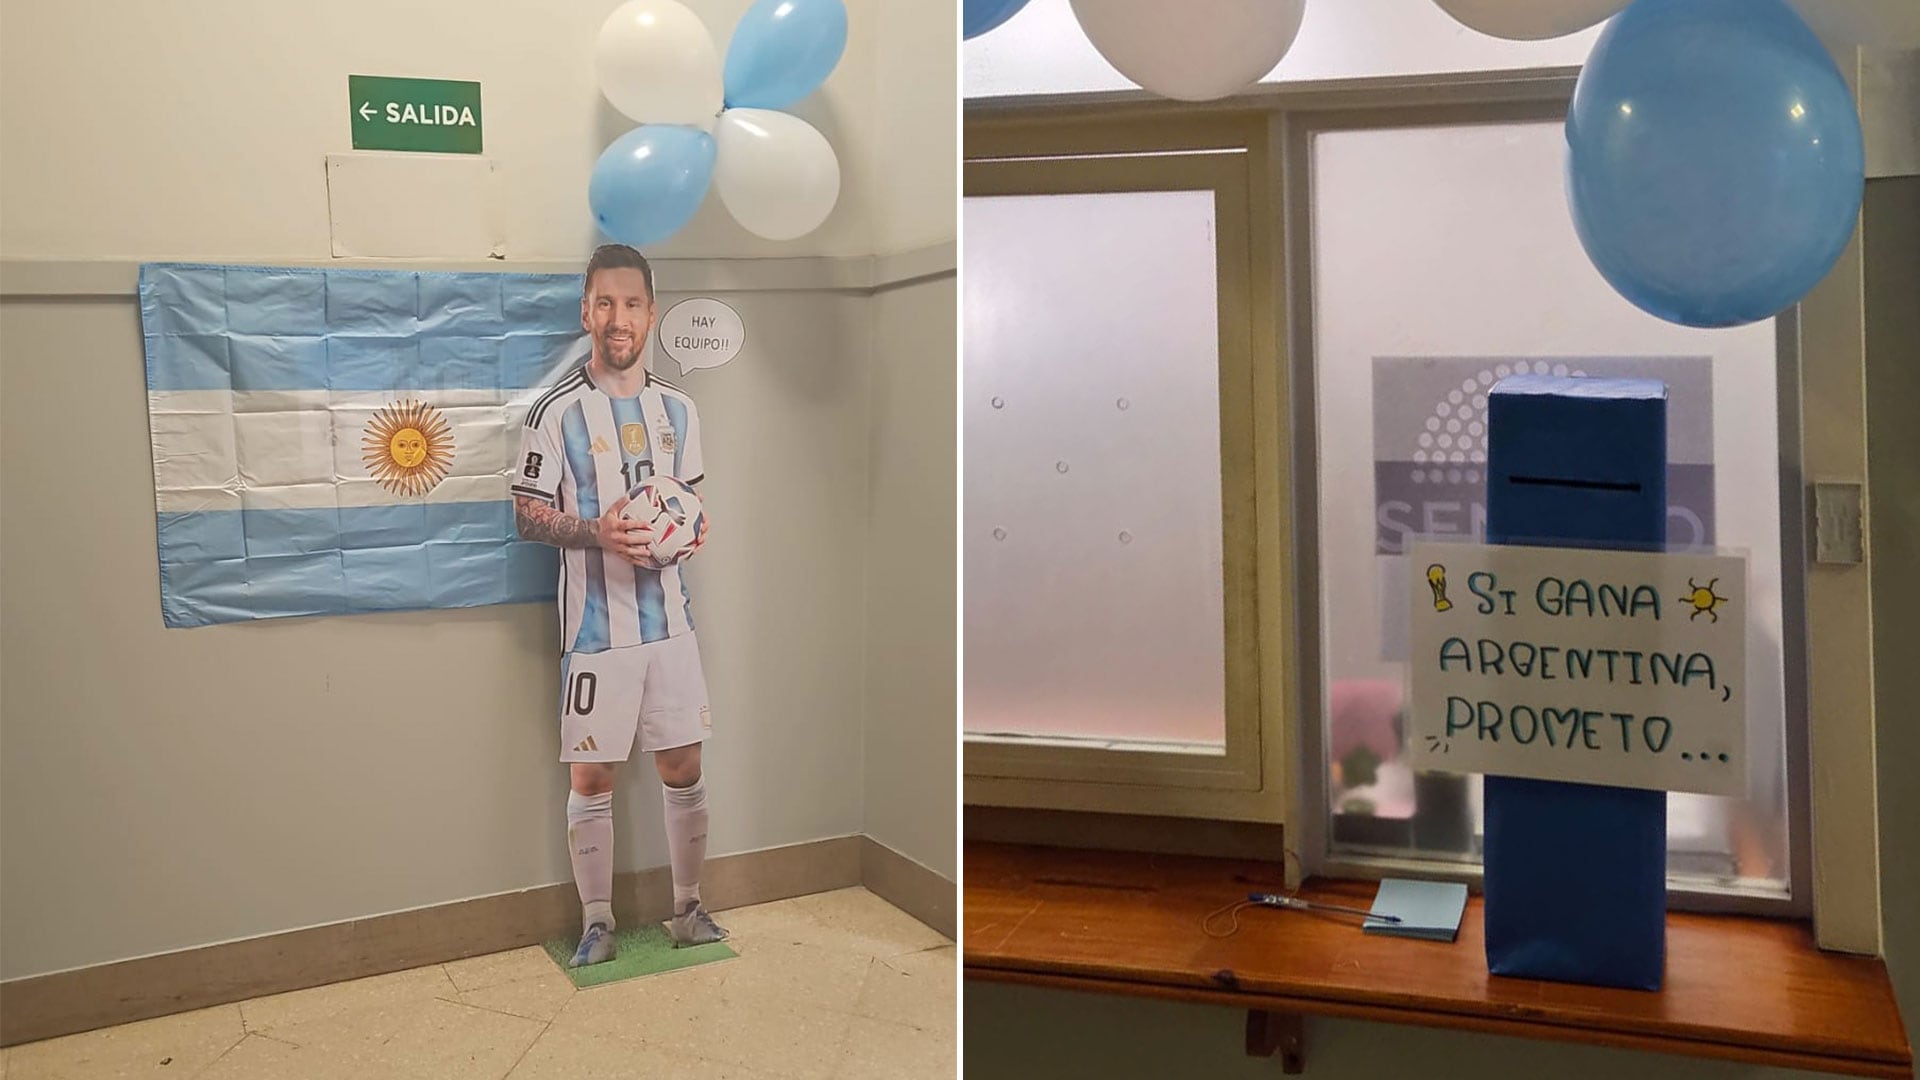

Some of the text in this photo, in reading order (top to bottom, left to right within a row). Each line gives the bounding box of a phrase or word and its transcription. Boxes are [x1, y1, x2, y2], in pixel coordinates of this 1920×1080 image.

[385, 102, 476, 126] SALIDA
[674, 336, 729, 351] EQUIPO!!
[691, 315, 716, 328] HAY
[1377, 500, 1706, 555] SEO
[1536, 576, 1661, 621] GANA
[1439, 636, 1731, 702] ARGENTINA,
[565, 672, 597, 716] 10
